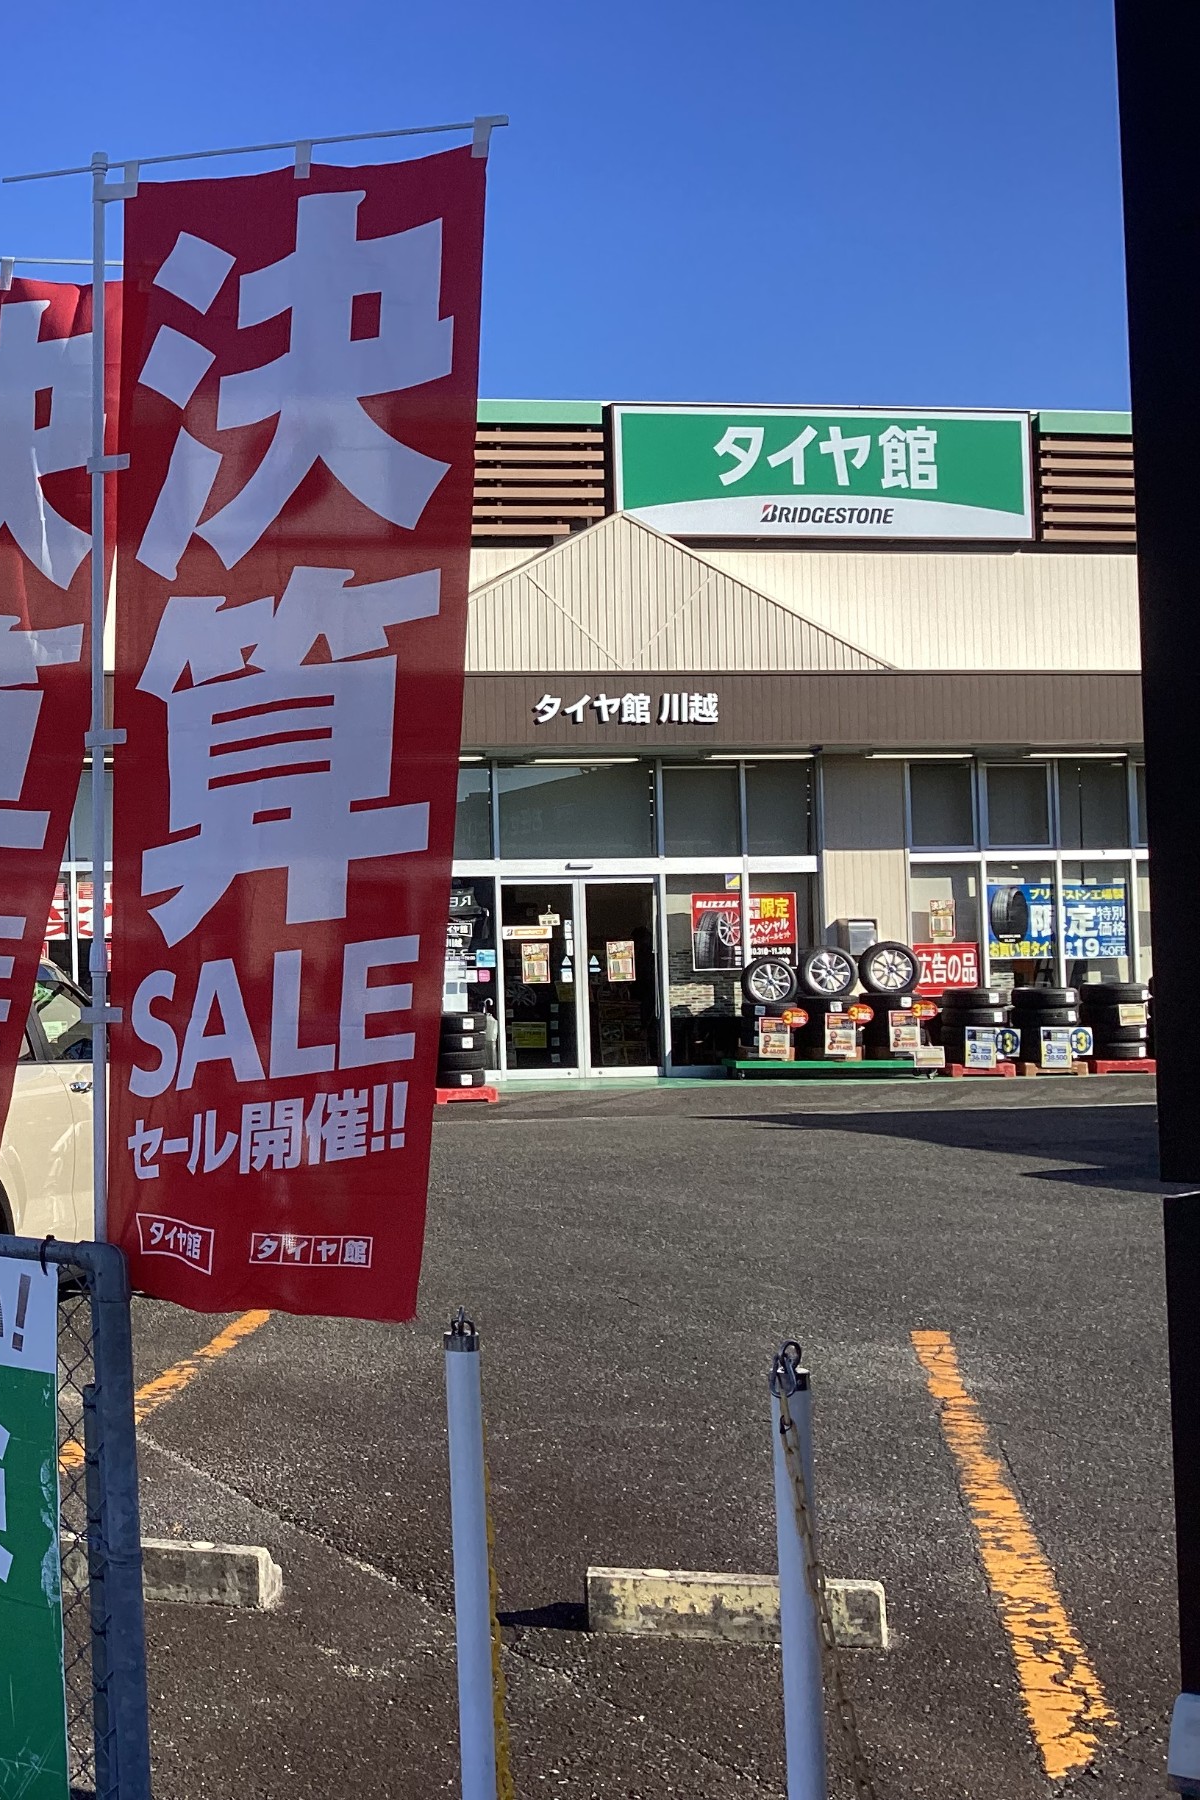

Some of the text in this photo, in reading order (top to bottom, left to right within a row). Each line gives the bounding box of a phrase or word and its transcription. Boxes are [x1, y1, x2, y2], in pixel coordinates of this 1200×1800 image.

[714, 425, 939, 490] タイヤ館
[760, 504, 894, 525] BRIDGESTONE
[135, 190, 454, 949] 決算
[534, 692, 719, 724] タイヤ館 川越
[695, 900, 739, 909] BLIZZAK
[760, 898, 790, 919] 限定
[989, 941, 1051, 957] お買い得タイ
[1074, 938, 1100, 957] 19
[1100, 945, 1126, 956] %OFF
[918, 952, 978, 984] 広告の品
[129, 934, 420, 1099] SALE
[127, 1081, 410, 1181] セール開催!!
[148, 1218, 204, 1261] タイヤ館
[253, 1233, 370, 1266] タイヤ館
